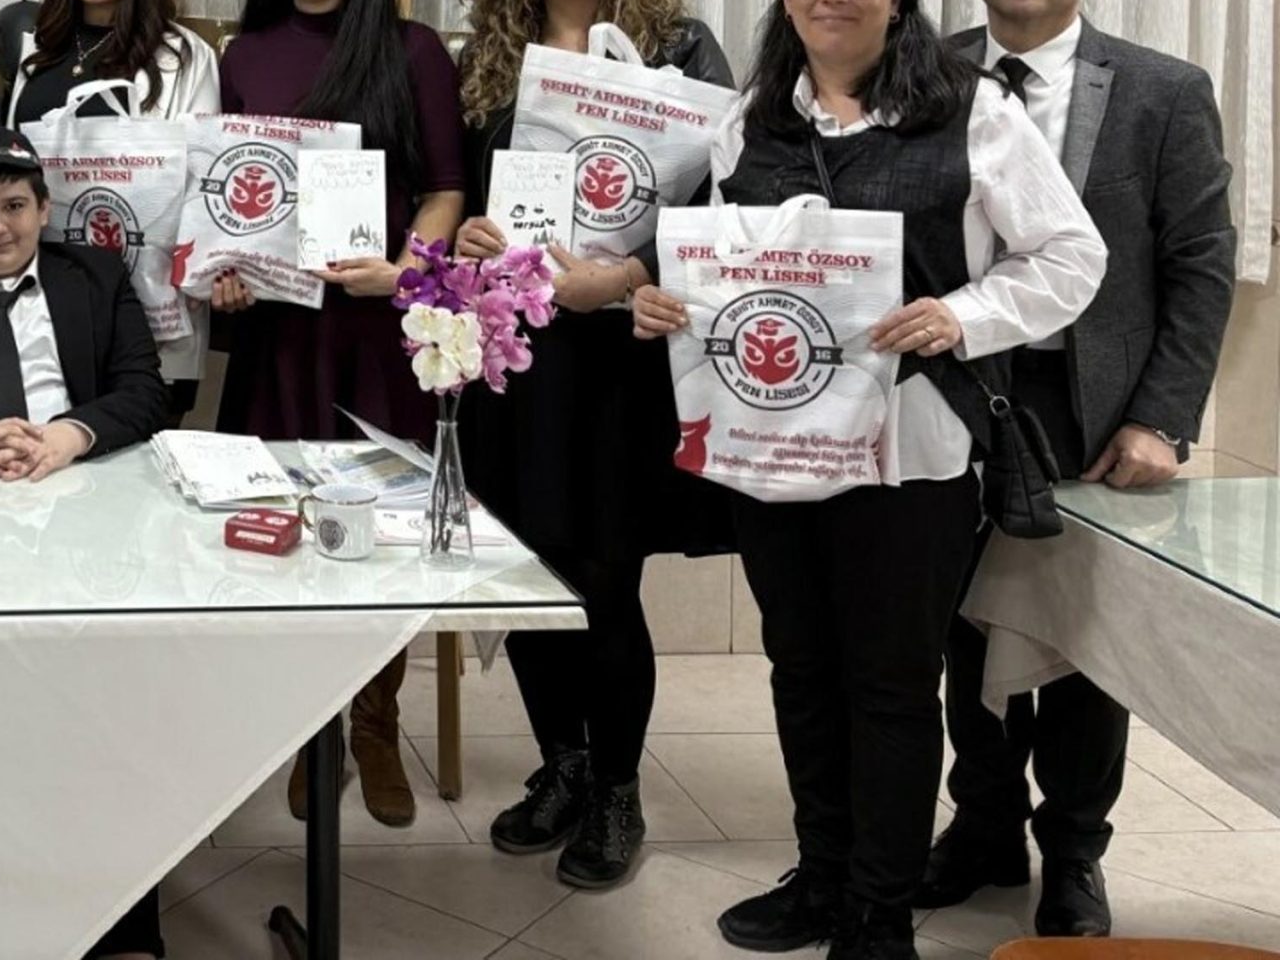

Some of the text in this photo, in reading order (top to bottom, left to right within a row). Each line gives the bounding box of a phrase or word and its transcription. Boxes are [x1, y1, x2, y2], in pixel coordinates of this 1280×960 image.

[576, 102, 609, 119] FEN
[593, 90, 653, 112] AHMET
[655, 101, 708, 127] ÖZSOY
[222, 122, 251, 135] FEN
[676, 245, 718, 261] ŞEH
[807, 249, 872, 272] ÖZSOY
[720, 266, 756, 280] FEN
